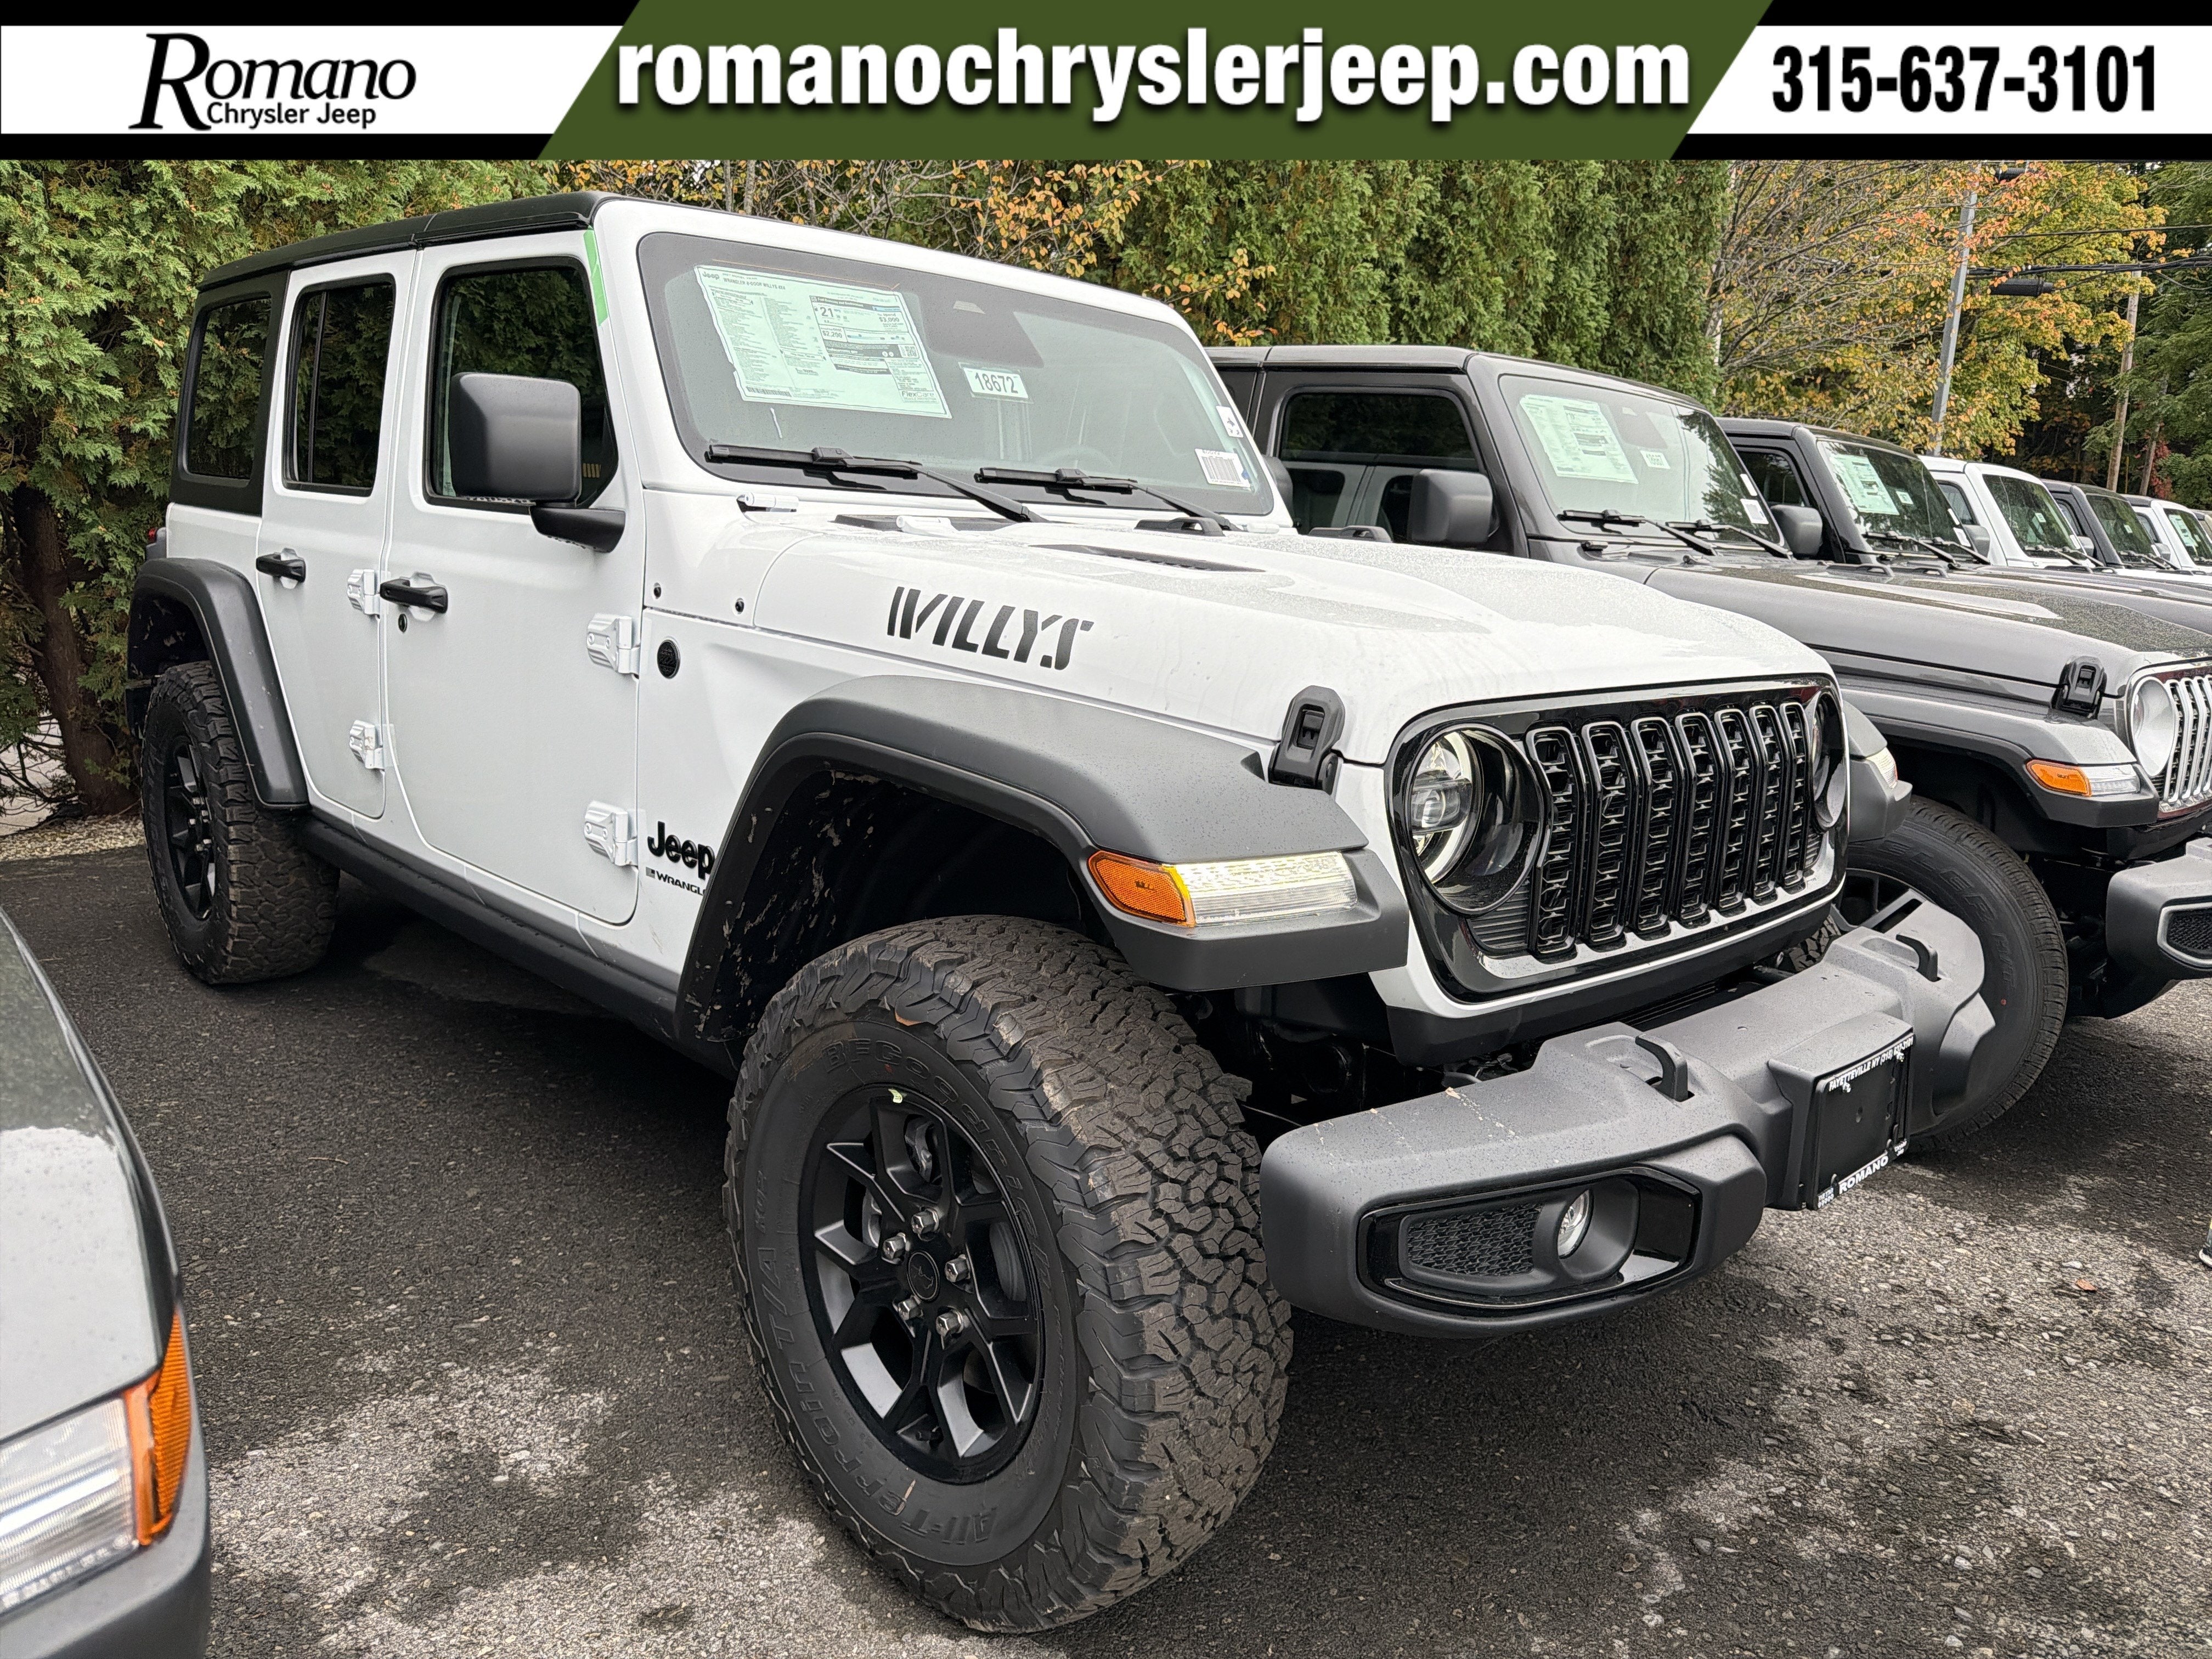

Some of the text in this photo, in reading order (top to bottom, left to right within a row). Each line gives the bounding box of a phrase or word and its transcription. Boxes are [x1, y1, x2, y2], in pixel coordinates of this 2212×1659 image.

[820, 306, 834, 317] 21
[974, 372, 1018, 394] 18672
[887, 586, 1094, 670] WILLYS
[647, 821, 715, 881] Jeep
[656, 870, 706, 896] WRANGL
[1829, 1060, 1871, 1092] FAYETTEVILLE
[1839, 1155, 1889, 1195] ROMANO
